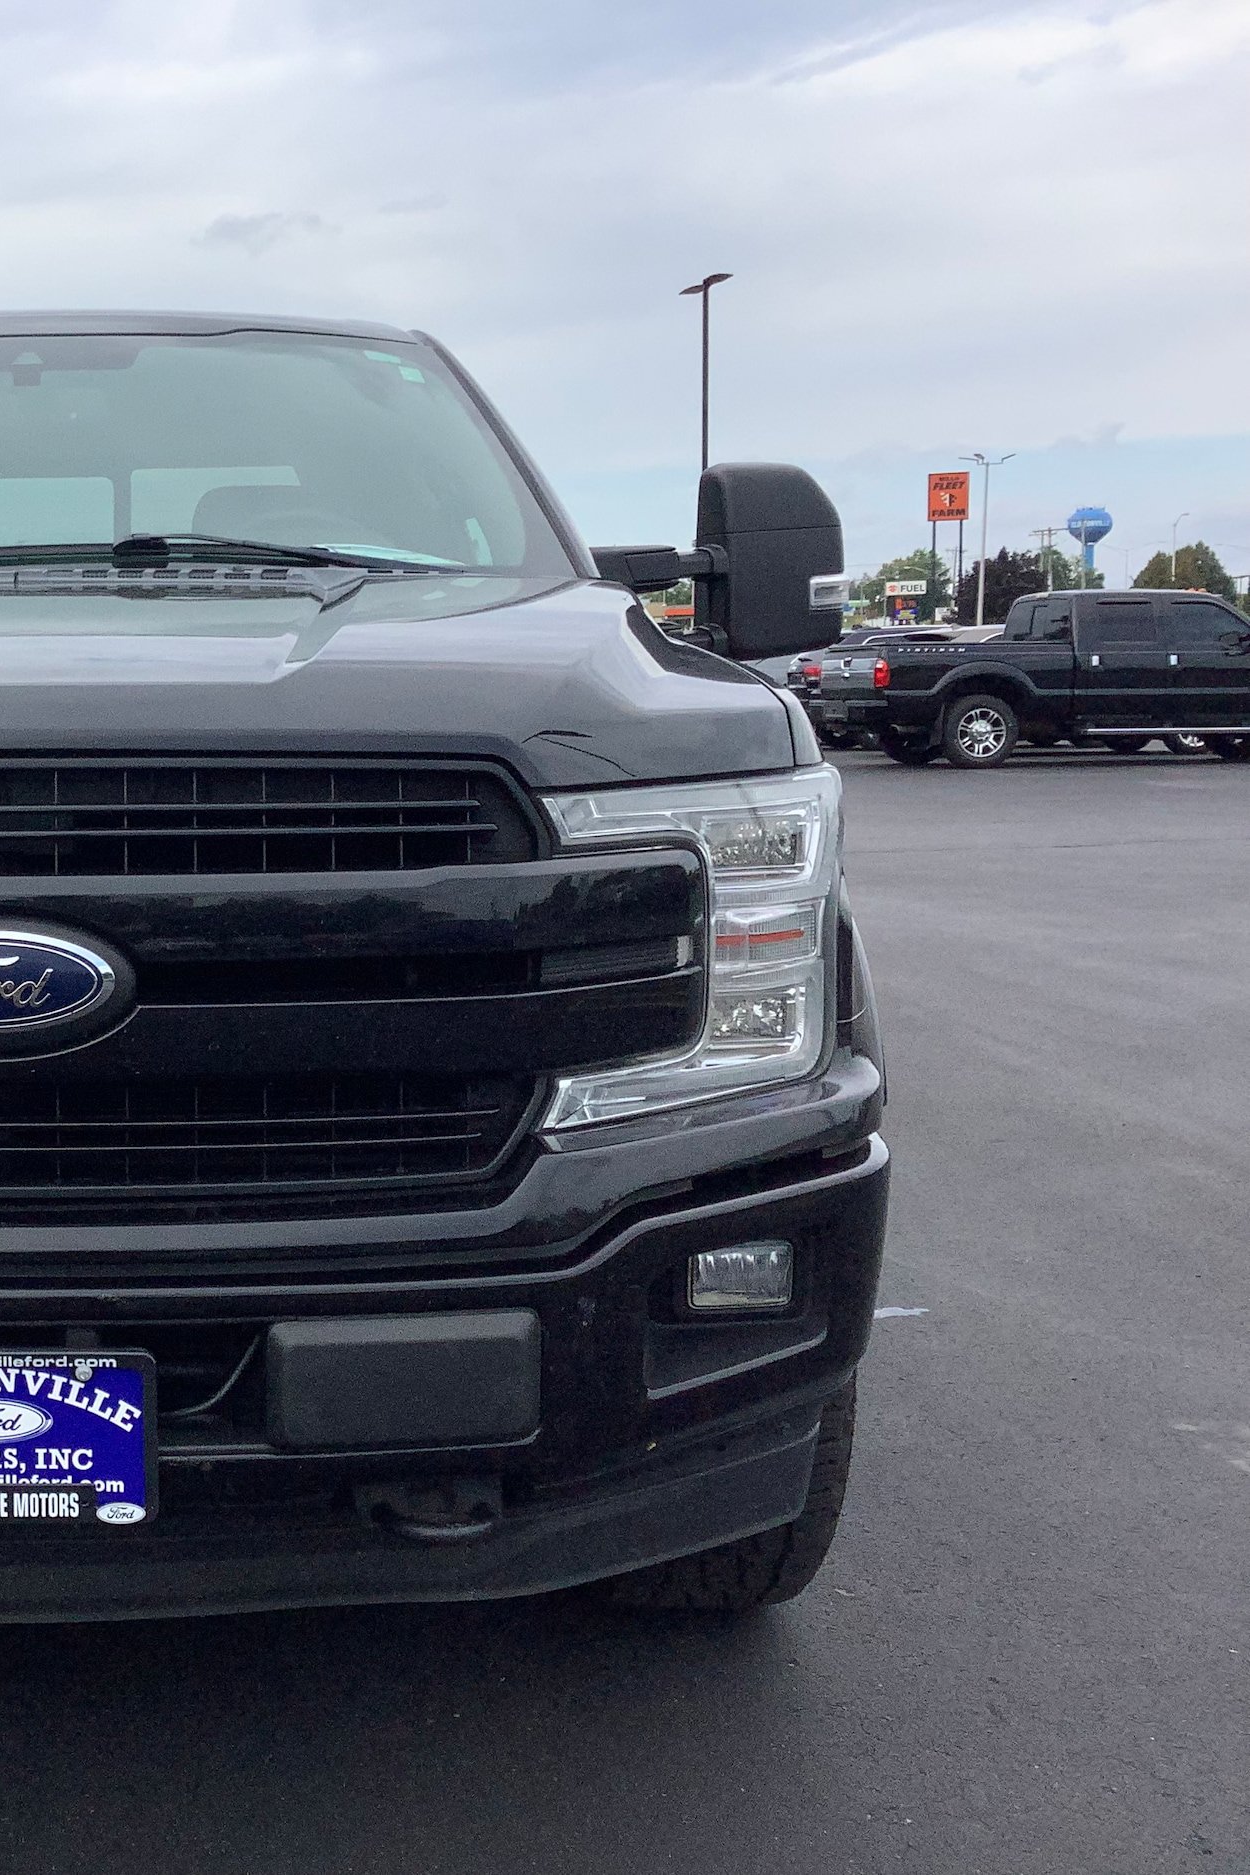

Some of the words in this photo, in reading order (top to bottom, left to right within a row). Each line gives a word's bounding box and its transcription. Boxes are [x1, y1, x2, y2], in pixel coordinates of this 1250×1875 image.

[932, 481, 966, 491] FLEET
[931, 508, 966, 518] FARM
[900, 584, 925, 592] FUEL
[34, 1448, 94, 1470] INC
[13, 1491, 80, 1518] MOTORS
[106, 1506, 135, 1521] Ford
